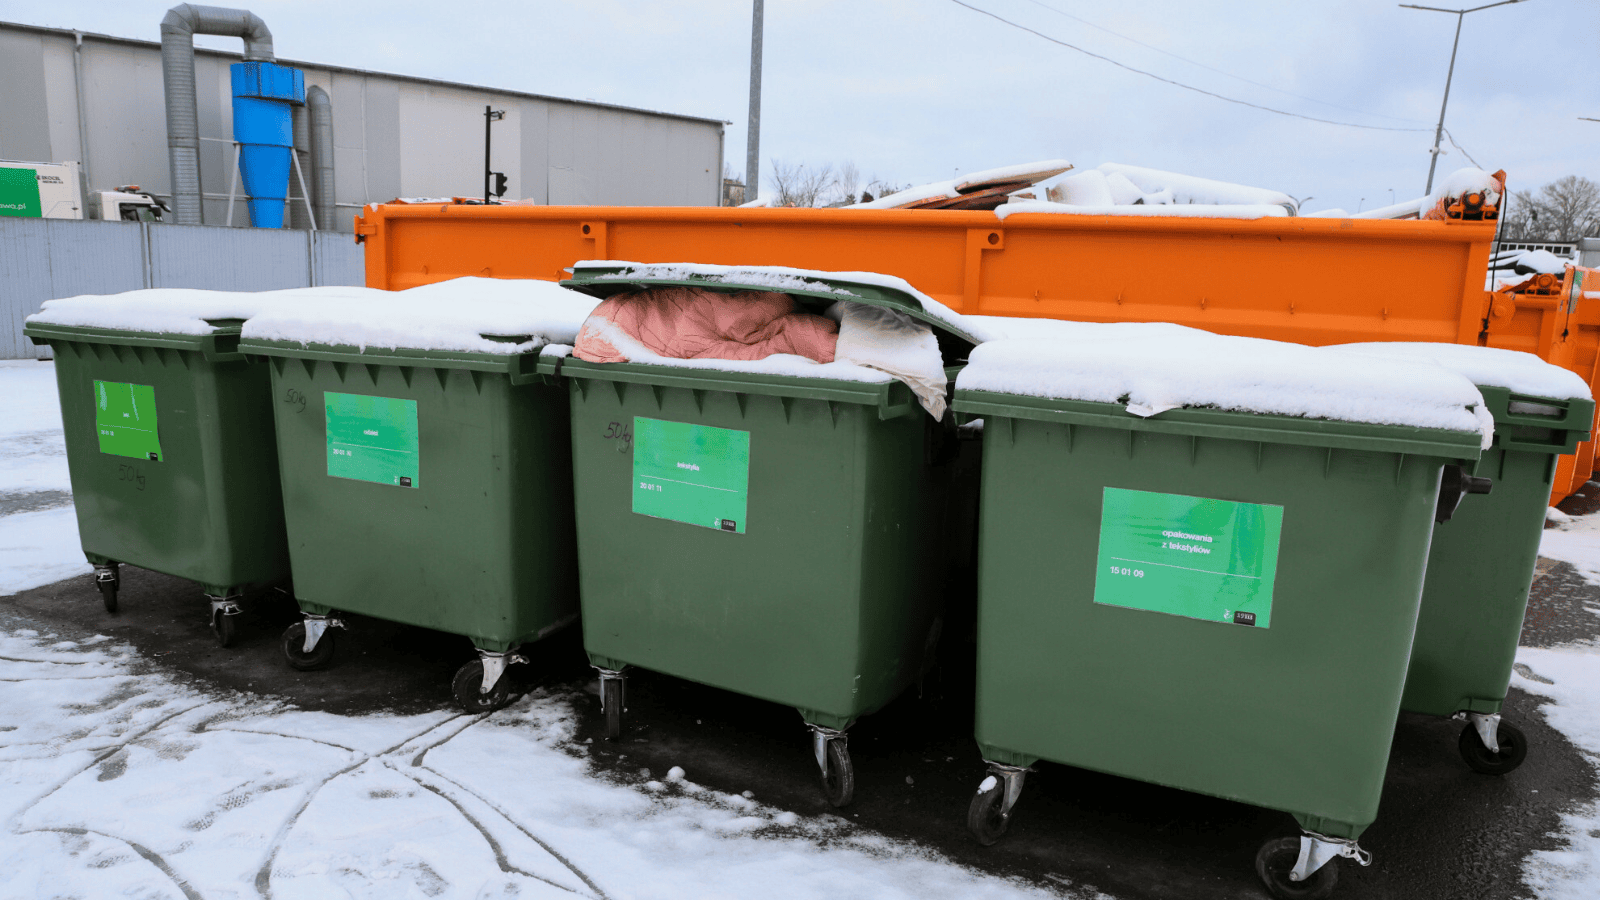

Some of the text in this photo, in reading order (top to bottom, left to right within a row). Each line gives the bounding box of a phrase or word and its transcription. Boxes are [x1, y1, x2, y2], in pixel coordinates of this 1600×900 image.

[1162, 530, 1213, 543] opakowania
[1169, 541, 1211, 555] tekstyliów
[1110, 566, 1145, 578] 15 01 09
